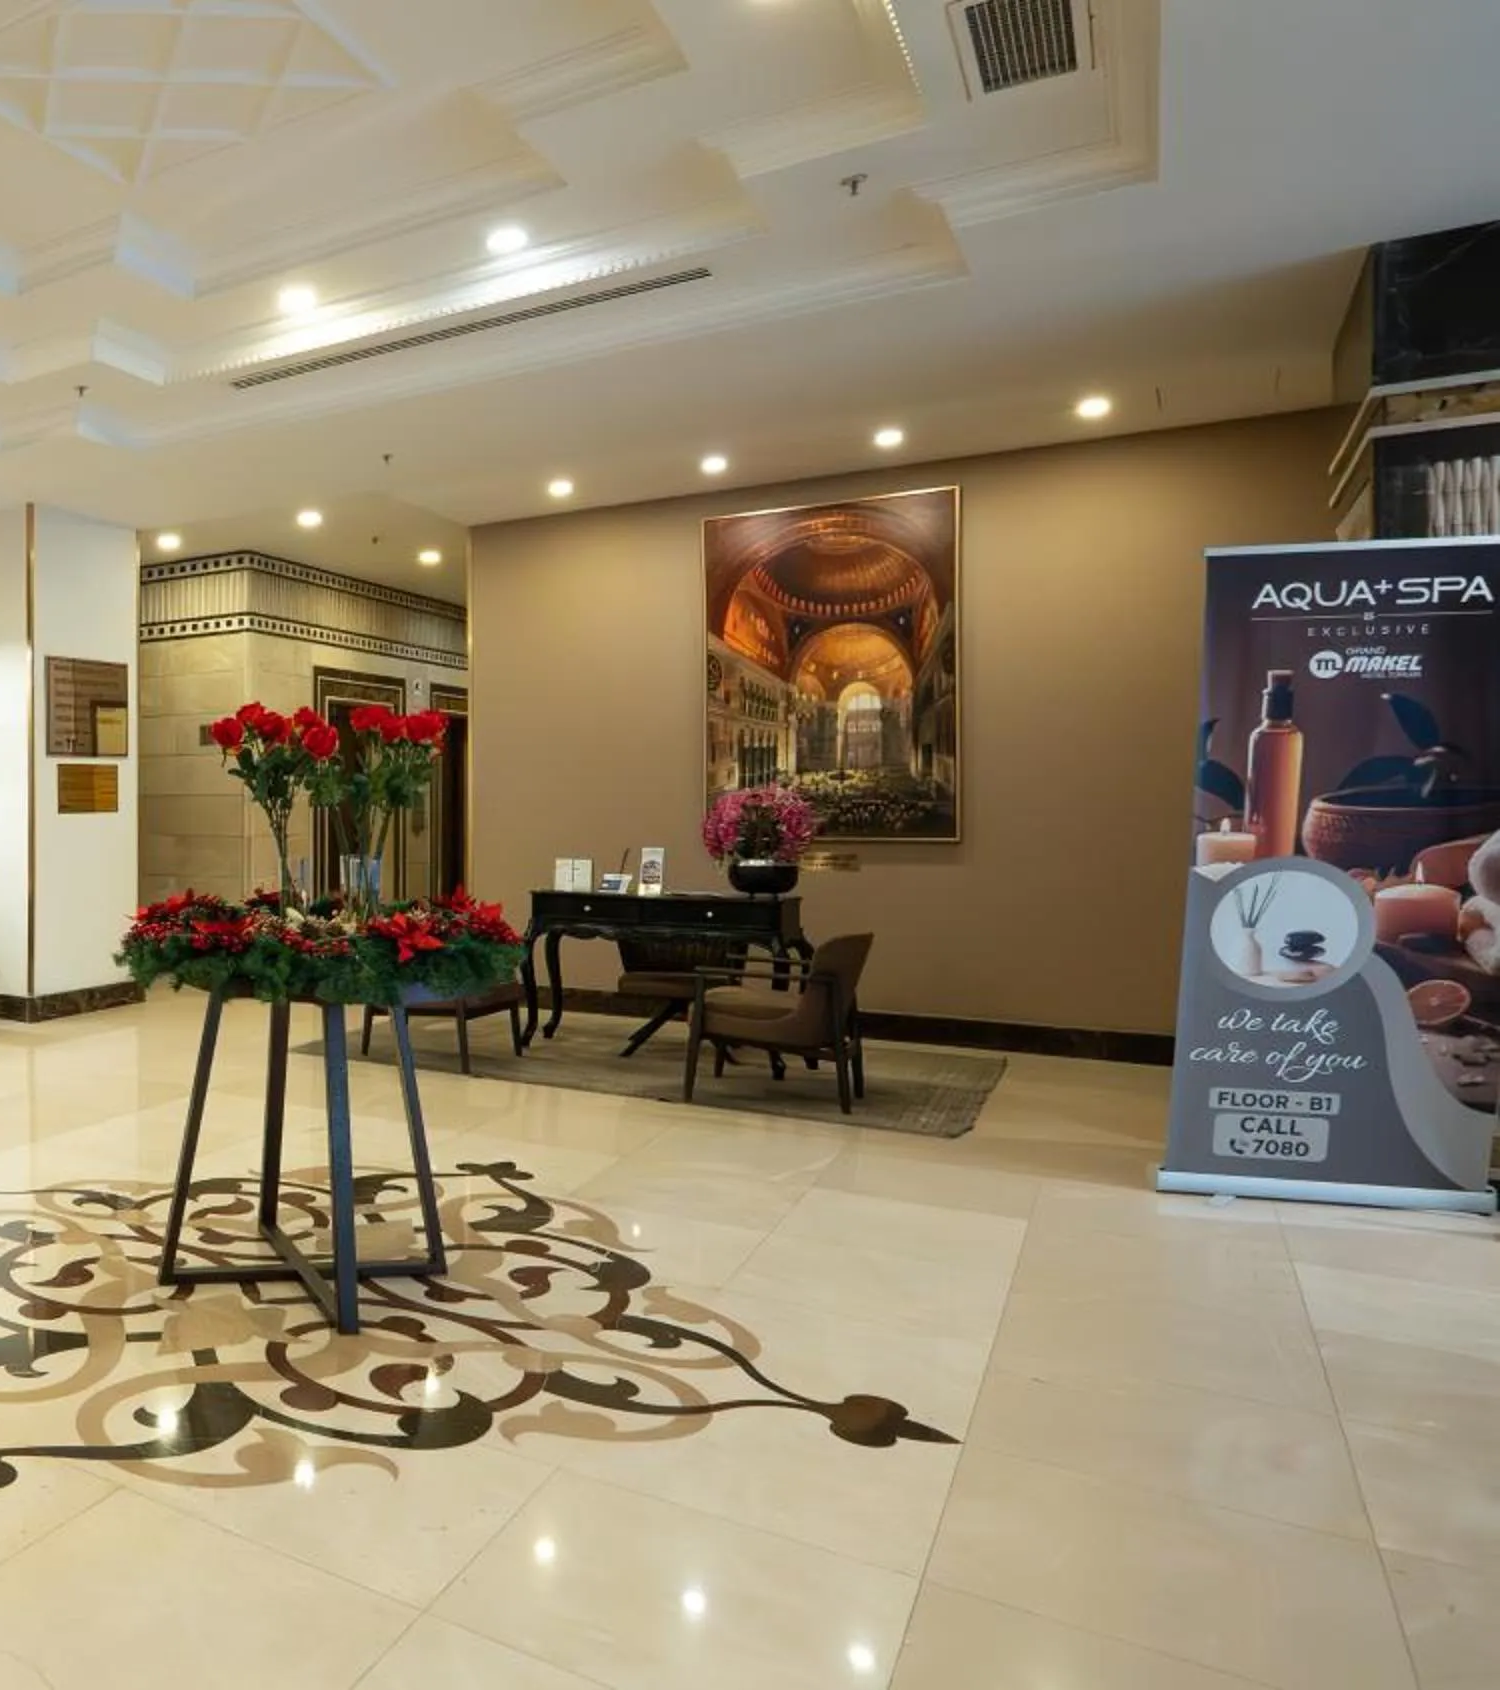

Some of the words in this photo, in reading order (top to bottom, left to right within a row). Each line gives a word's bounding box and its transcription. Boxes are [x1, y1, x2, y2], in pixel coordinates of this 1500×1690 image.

[1307, 623, 1430, 637] EXCLUSIVE
[1344, 655, 1423, 673] MAKEL
[1270, 1007, 1340, 1045] take
[1189, 1041, 1258, 1063] care
[1265, 1041, 1307, 1077] of
[1284, 1052, 1367, 1083] you
[1218, 1092, 1289, 1109] FLOOR
[1309, 1097, 1333, 1112] B1
[1241, 1116, 1303, 1136] CALL
[1252, 1139, 1309, 1157] 7080
